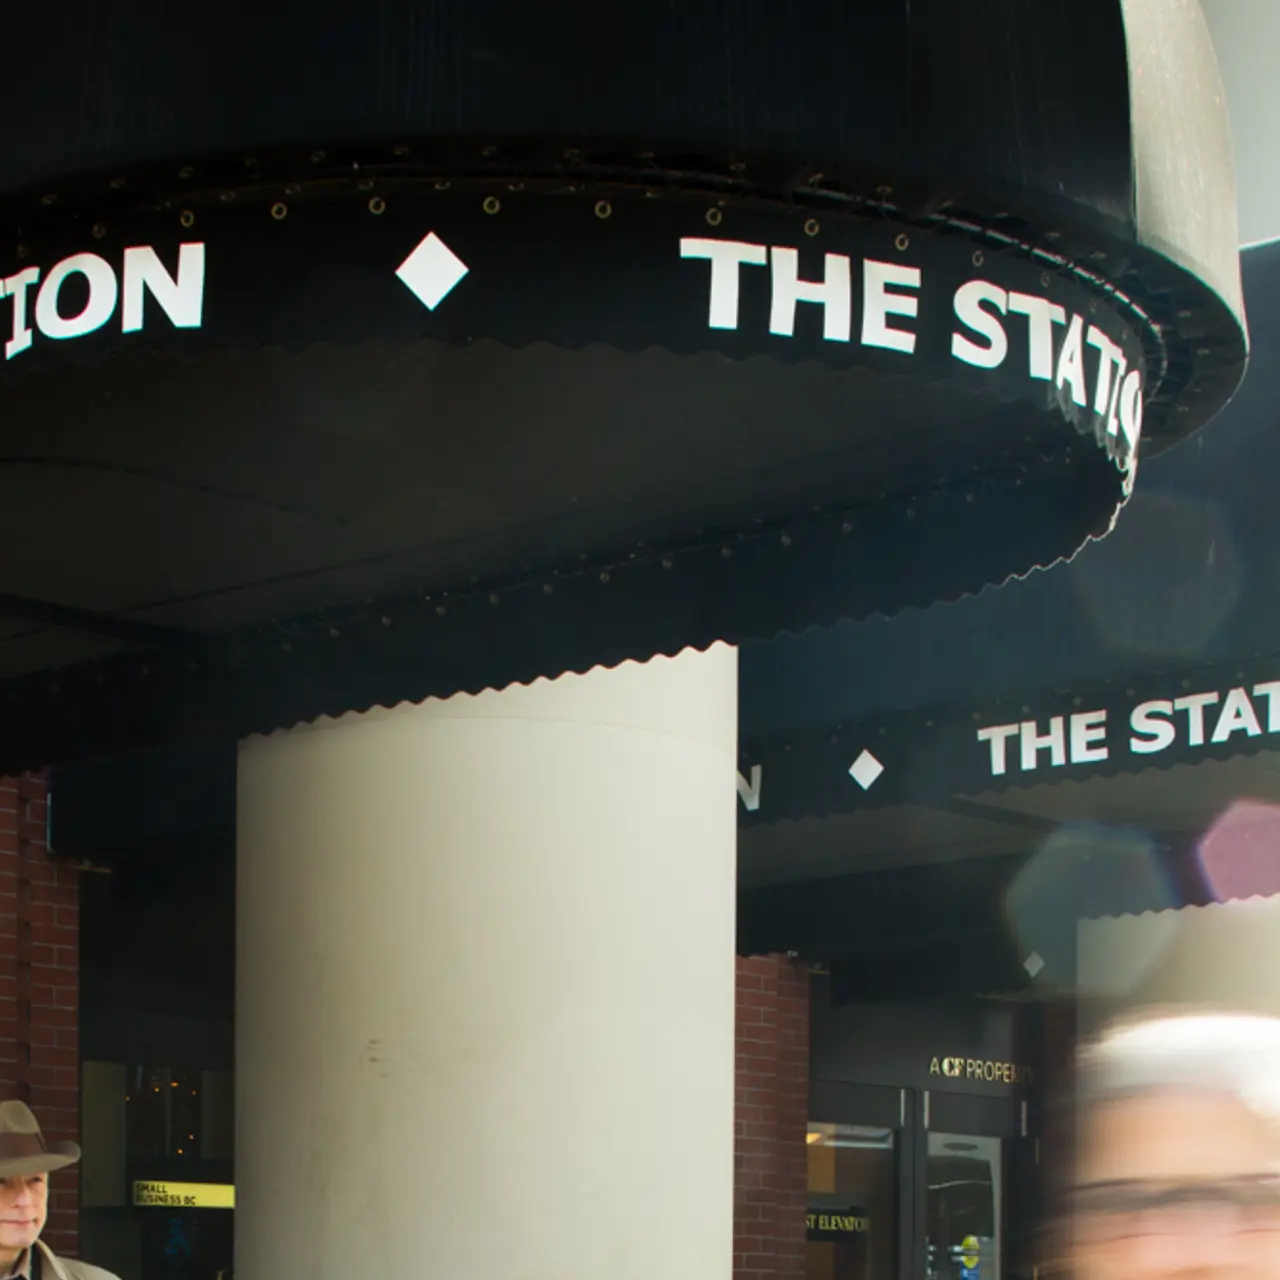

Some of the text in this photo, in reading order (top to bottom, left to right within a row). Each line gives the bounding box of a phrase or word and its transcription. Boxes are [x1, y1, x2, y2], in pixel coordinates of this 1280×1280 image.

[680, 237, 922, 354] THE
[977, 710, 1110, 776] THE
[929, 1056, 941, 1076] A
[136, 1182, 168, 1194] SMALL
